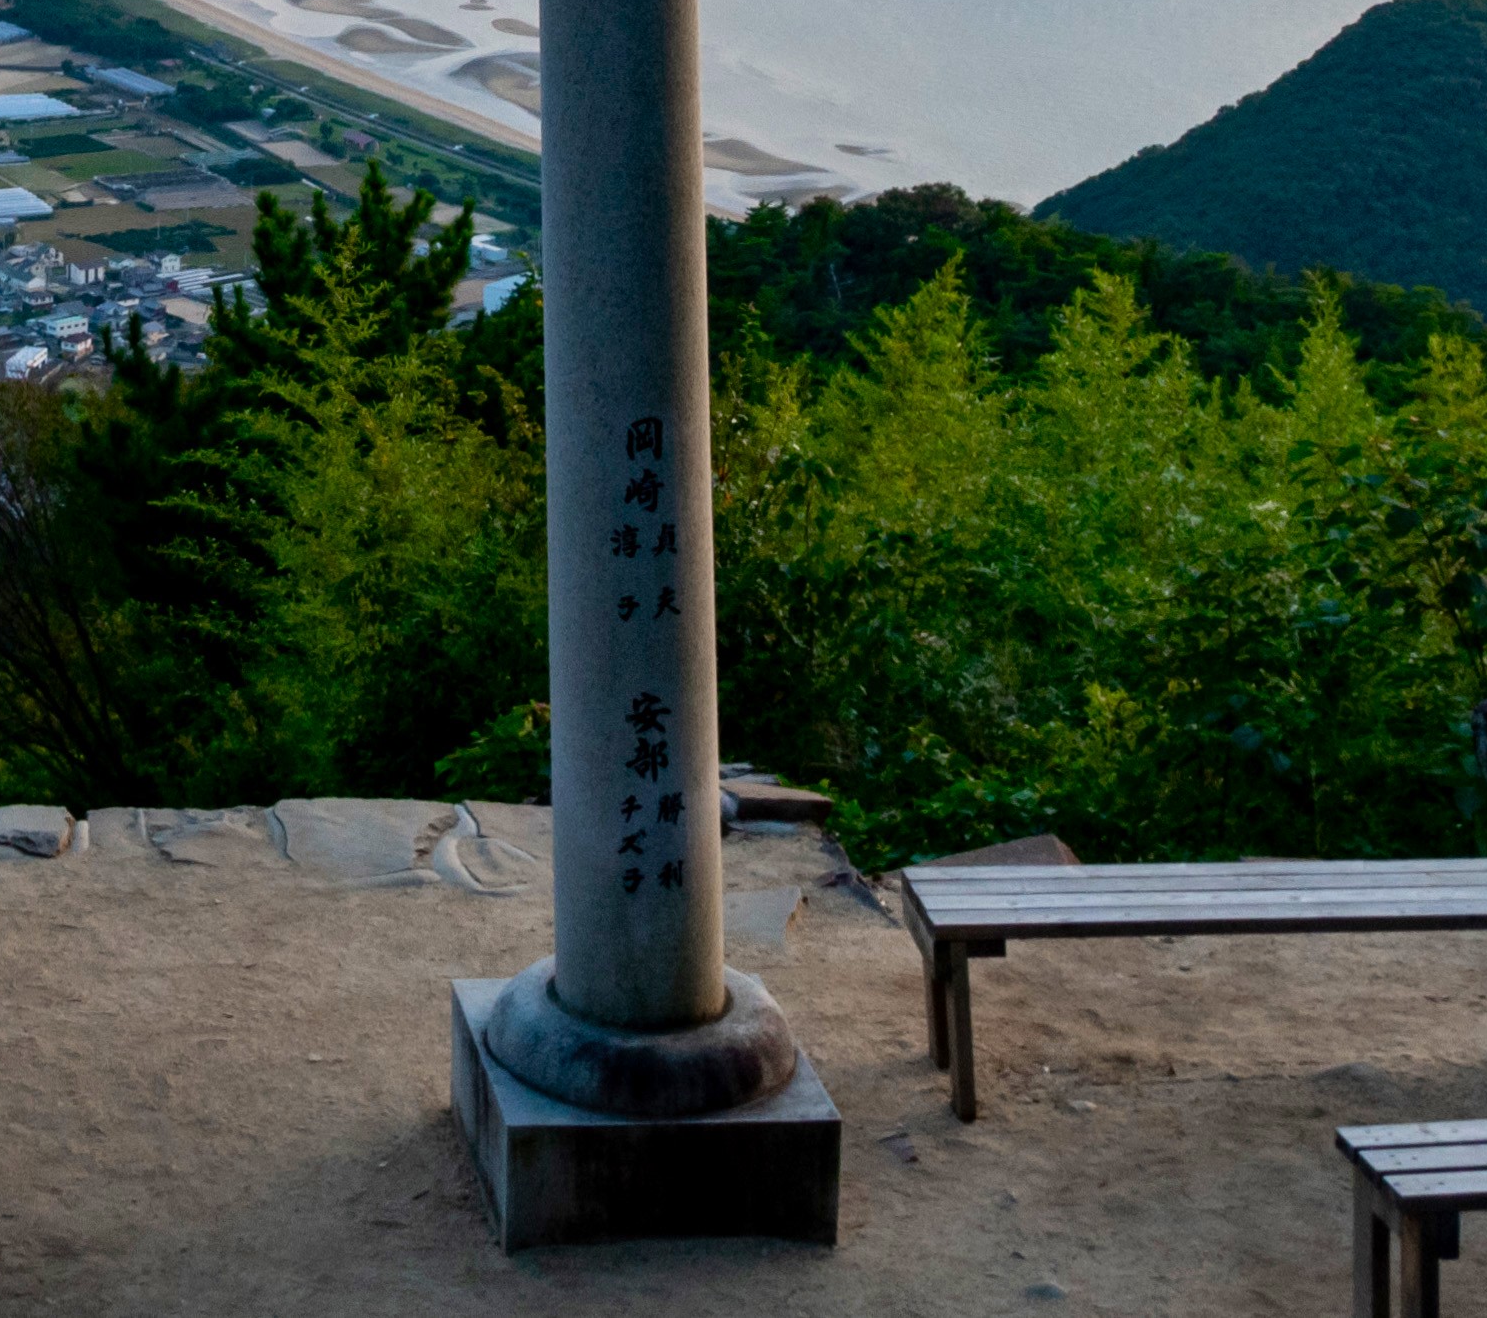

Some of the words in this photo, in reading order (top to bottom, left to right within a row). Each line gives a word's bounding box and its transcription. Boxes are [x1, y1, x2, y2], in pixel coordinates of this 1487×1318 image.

[624, 416, 665, 512] 岡崎
[610, 523, 642, 622] 淳子
[651, 522, 681, 620] 貞夫
[624, 691, 672, 783] 安部
[656, 791, 686, 890] 勝利
